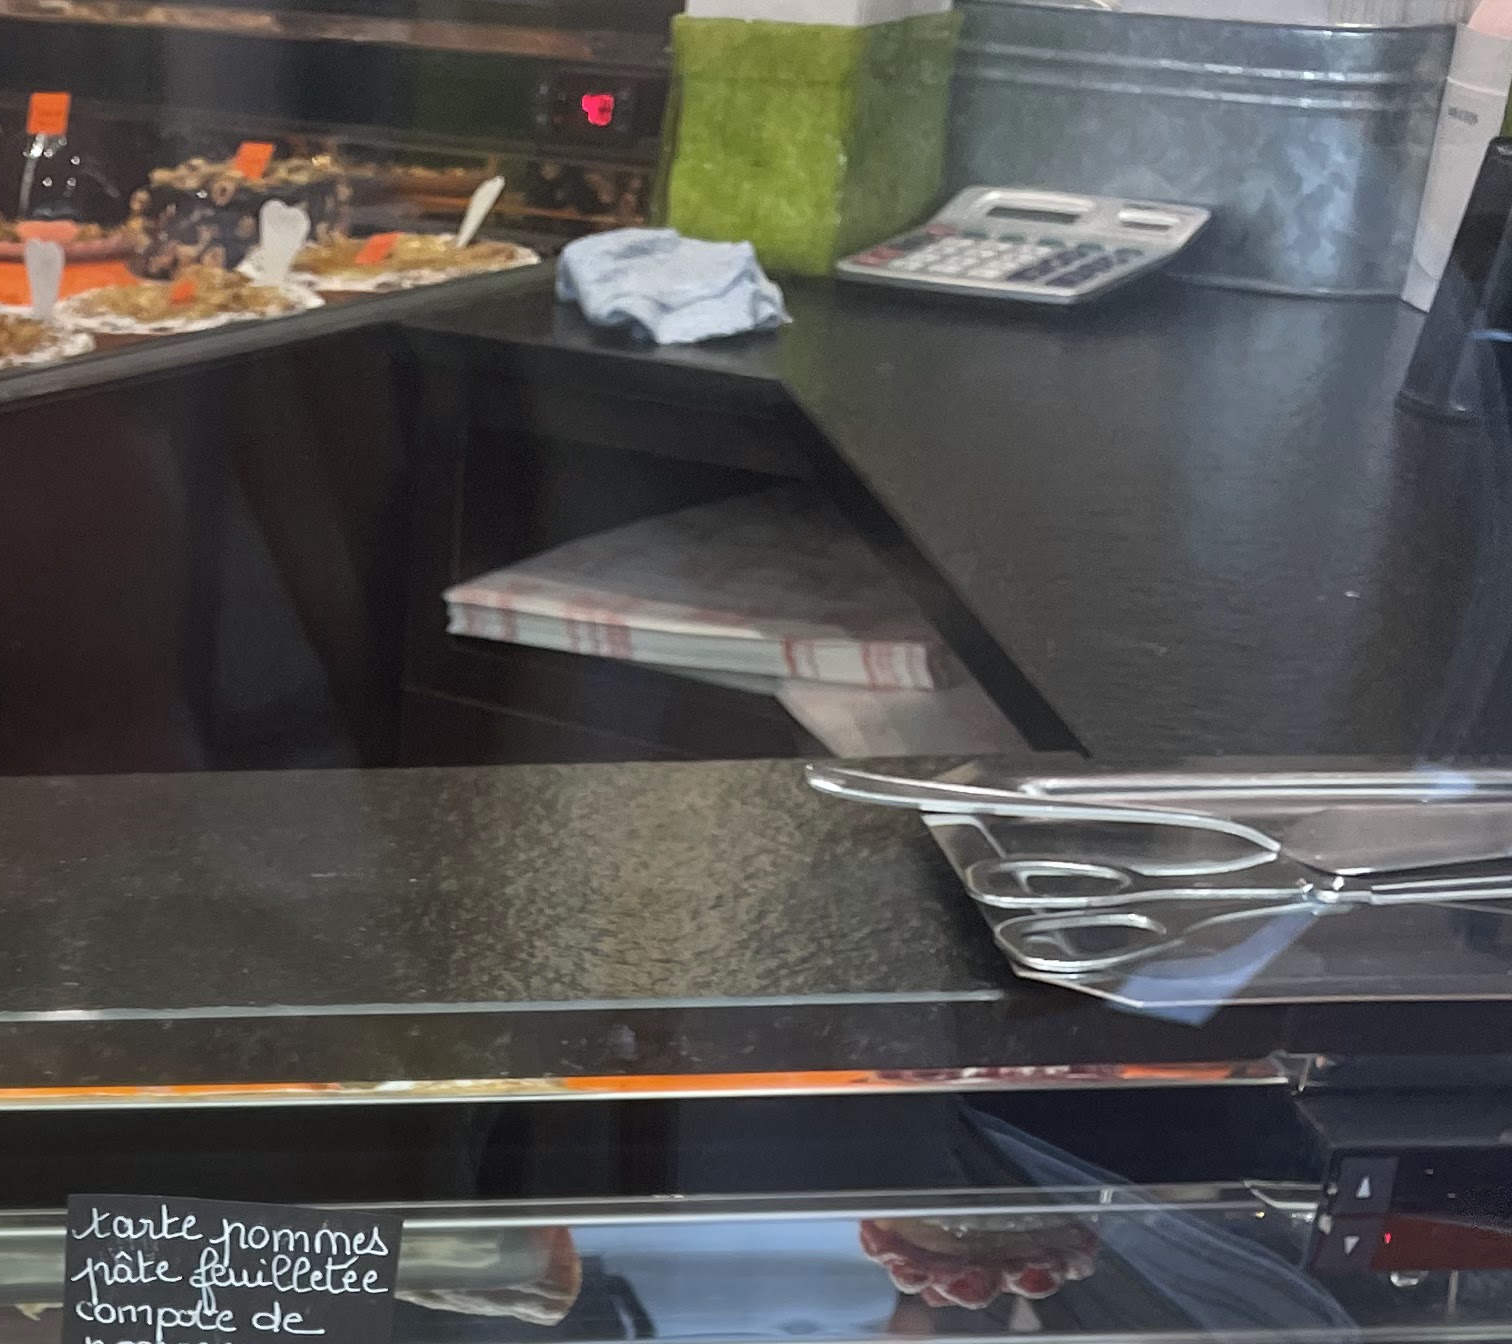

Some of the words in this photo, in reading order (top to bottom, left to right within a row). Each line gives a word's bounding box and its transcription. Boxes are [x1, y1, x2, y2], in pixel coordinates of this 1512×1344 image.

[71, 1203, 203, 1239] tarte
[209, 1218, 389, 1267] pommes
[71, 1249, 183, 1304] pâte
[76, 1299, 237, 1343] compote
[252, 1300, 325, 1335] de
